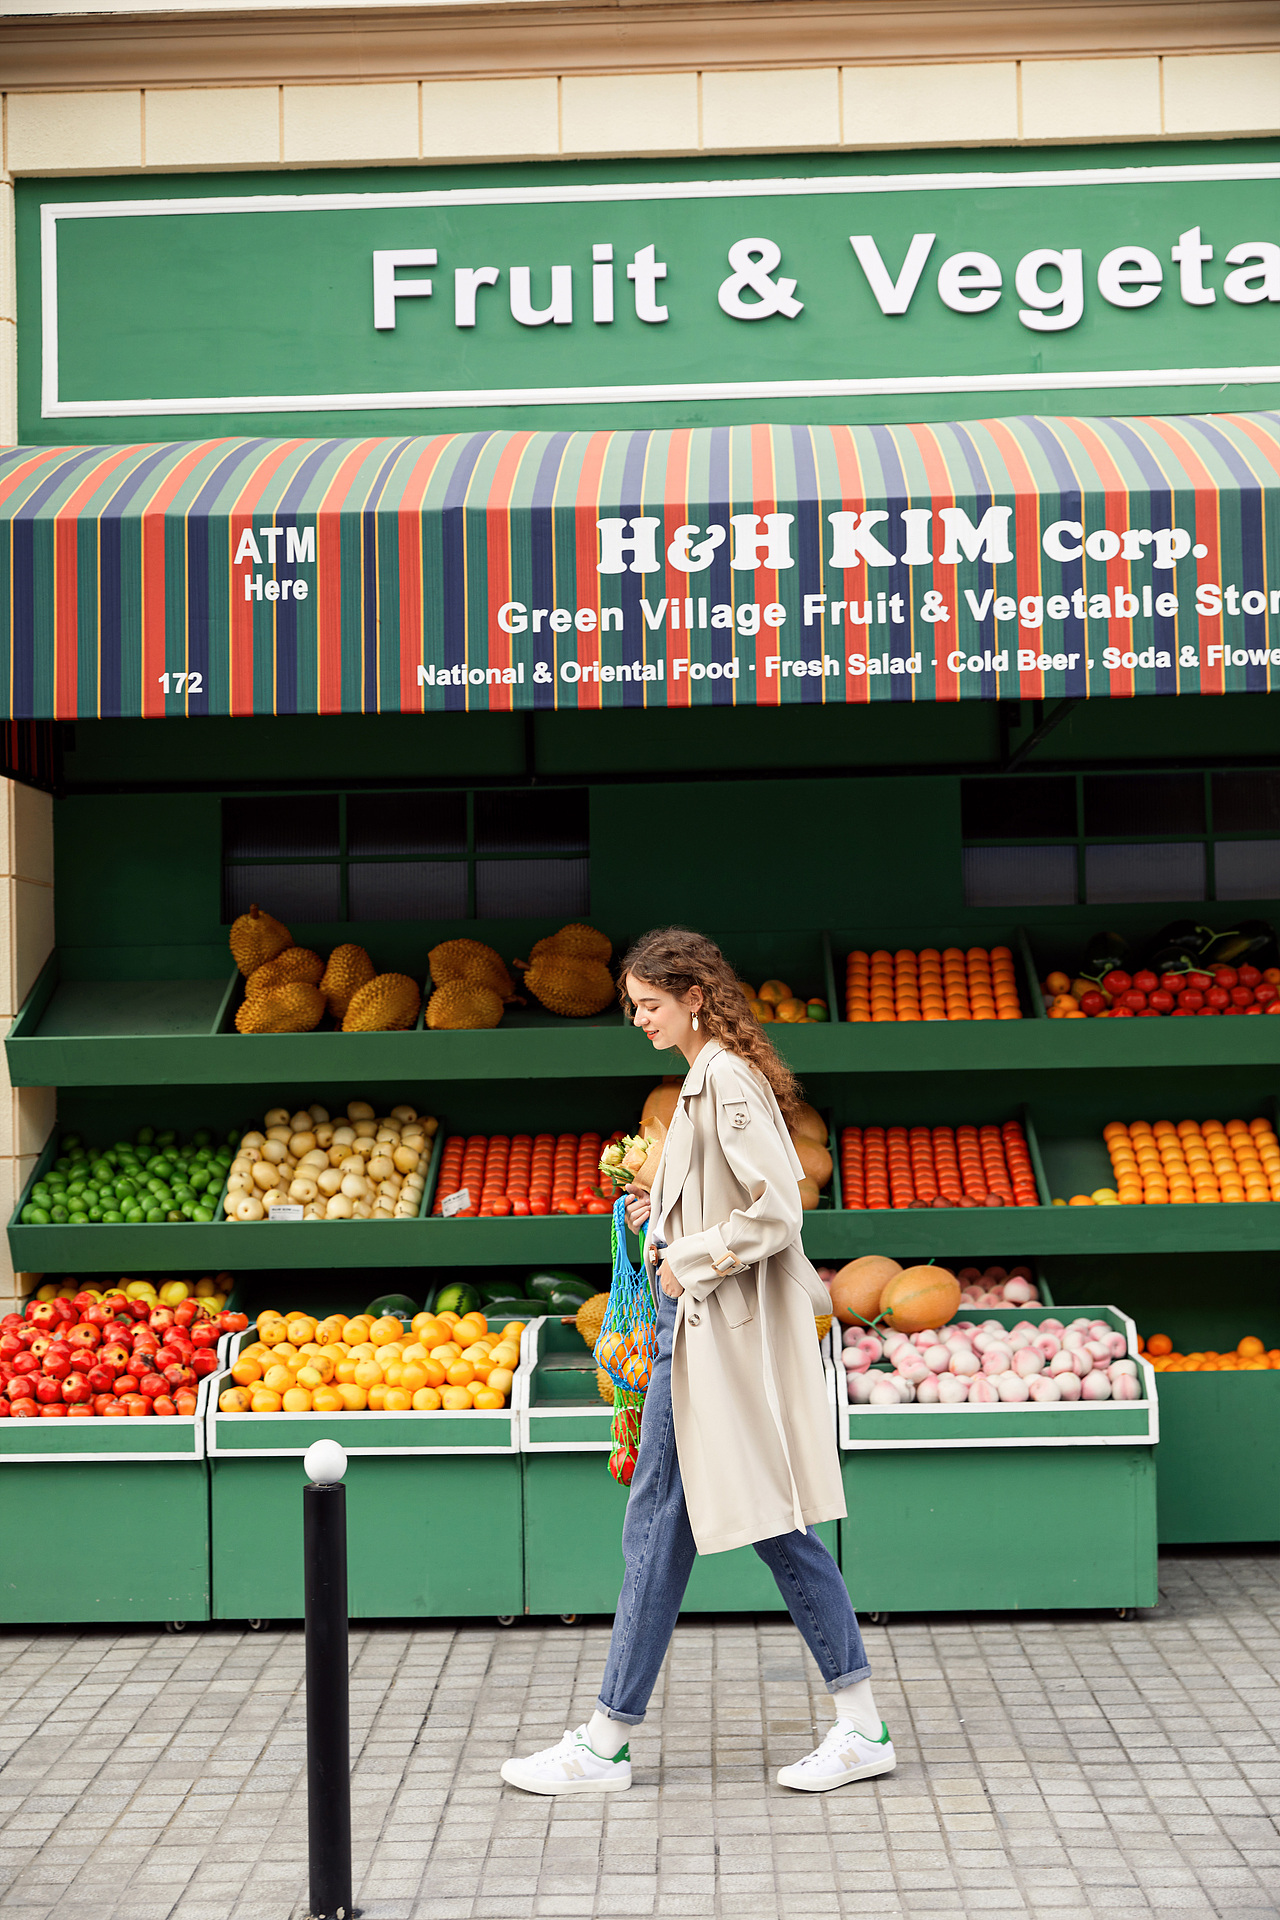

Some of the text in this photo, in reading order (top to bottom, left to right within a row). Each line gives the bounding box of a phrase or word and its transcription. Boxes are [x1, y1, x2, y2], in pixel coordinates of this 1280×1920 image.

[372, 225, 1280, 332] Fruit & Vegeta
[233, 526, 316, 566] ATM
[595, 505, 1209, 575] H&H KIM Corp.
[244, 573, 309, 601] Here
[497, 601, 624, 634] Green
[639, 597, 787, 635] Village
[803, 590, 905, 626] Fruit
[920, 590, 951, 623] &
[963, 585, 1179, 629] Vegetable
[158, 672, 203, 694] 172
[417, 663, 525, 687] National
[532, 661, 553, 684] &
[560, 658, 664, 683] Oriental
[672, 656, 739, 680] Food
[765, 655, 840, 678] Fresh
[847, 652, 922, 677] Salad
[946, 649, 1009, 673] Cold
[1102, 646, 1172, 670] Soda
[1178, 645, 1200, 668] &
